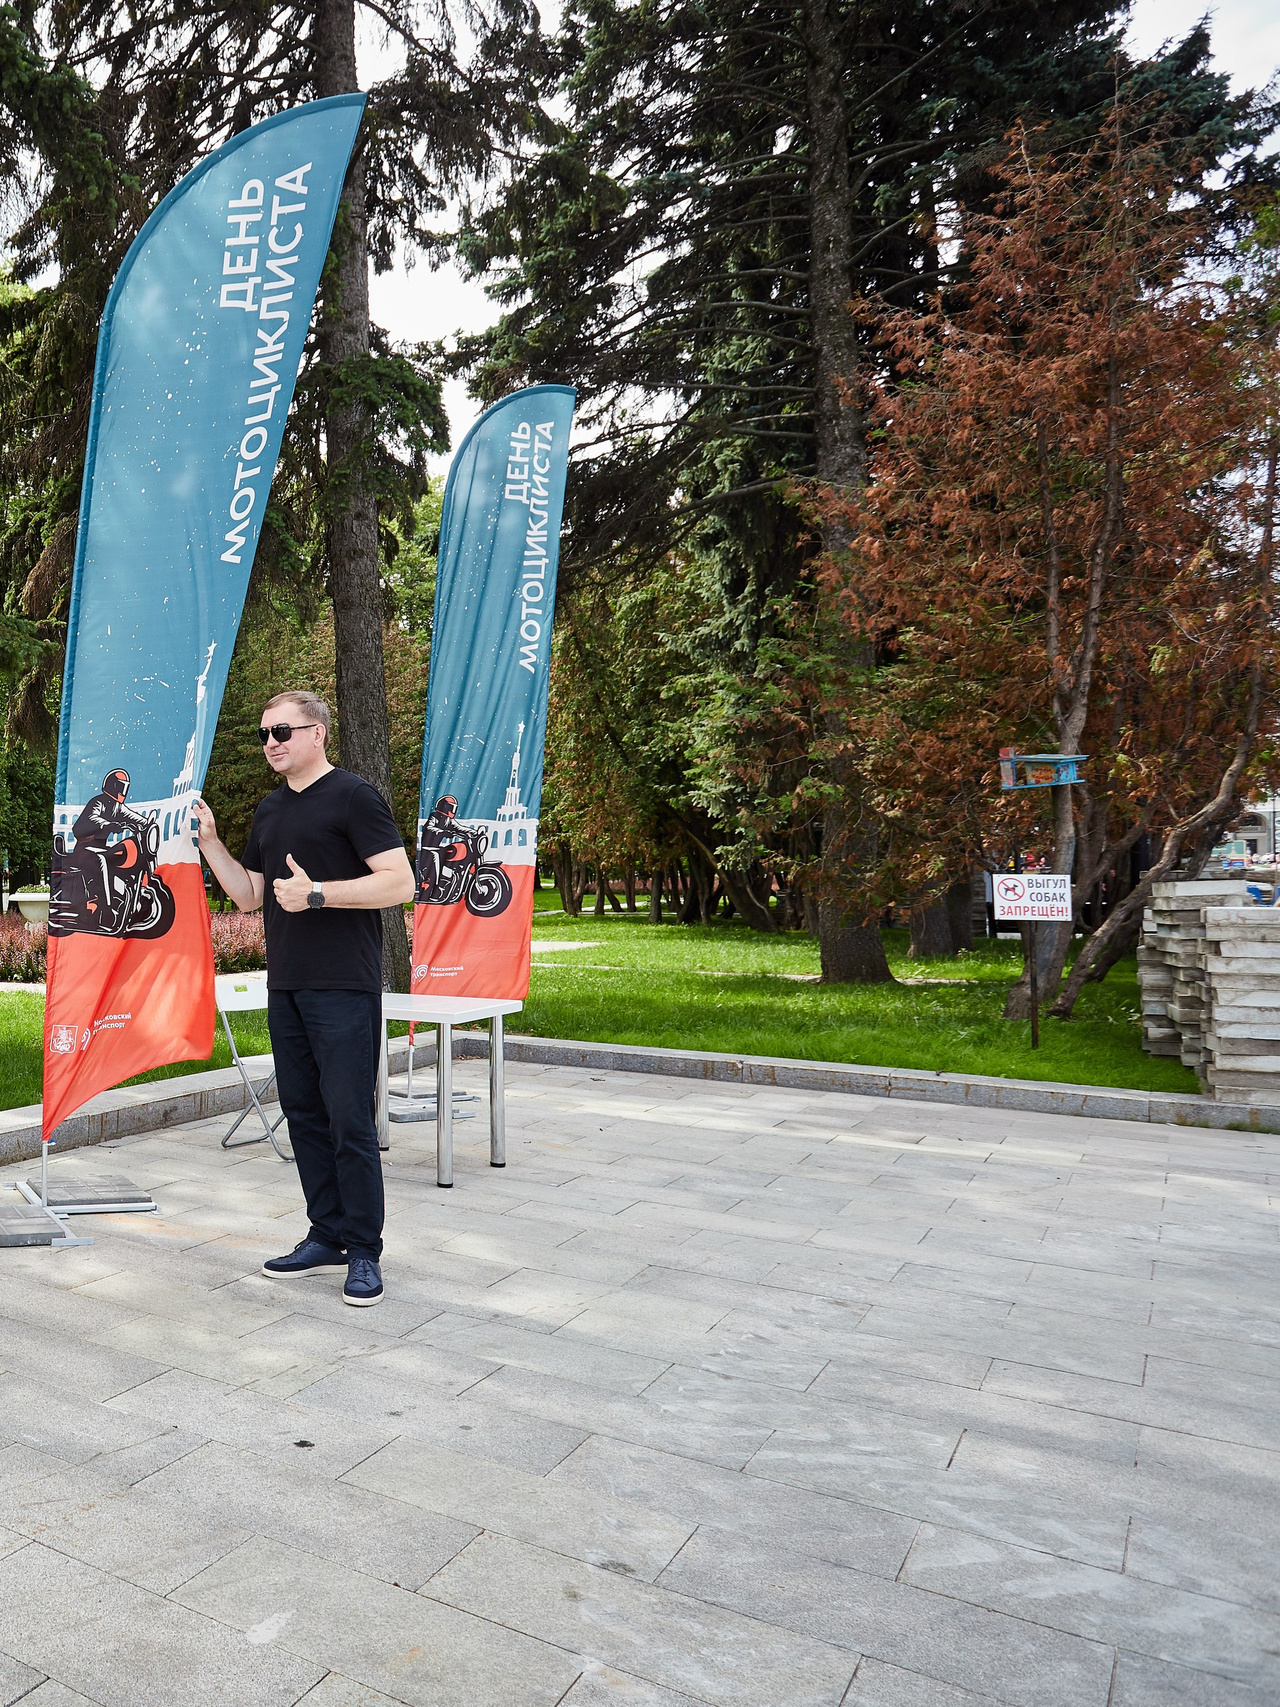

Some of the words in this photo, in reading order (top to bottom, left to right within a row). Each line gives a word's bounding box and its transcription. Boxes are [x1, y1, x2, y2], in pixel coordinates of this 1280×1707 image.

[219, 178, 265, 313] ДЕНЬ
[220, 161, 313, 564] МОТОЦИКЛИСТА
[504, 421, 531, 504] ДЕНЬ
[519, 421, 555, 674] МОТОЦИКЛИСТА
[999, 904, 1069, 917] ЗАПРЕЩЁН!
[1027, 878, 1067, 890] ВЫГУЛ
[1029, 892, 1066, 903] СОБАК
